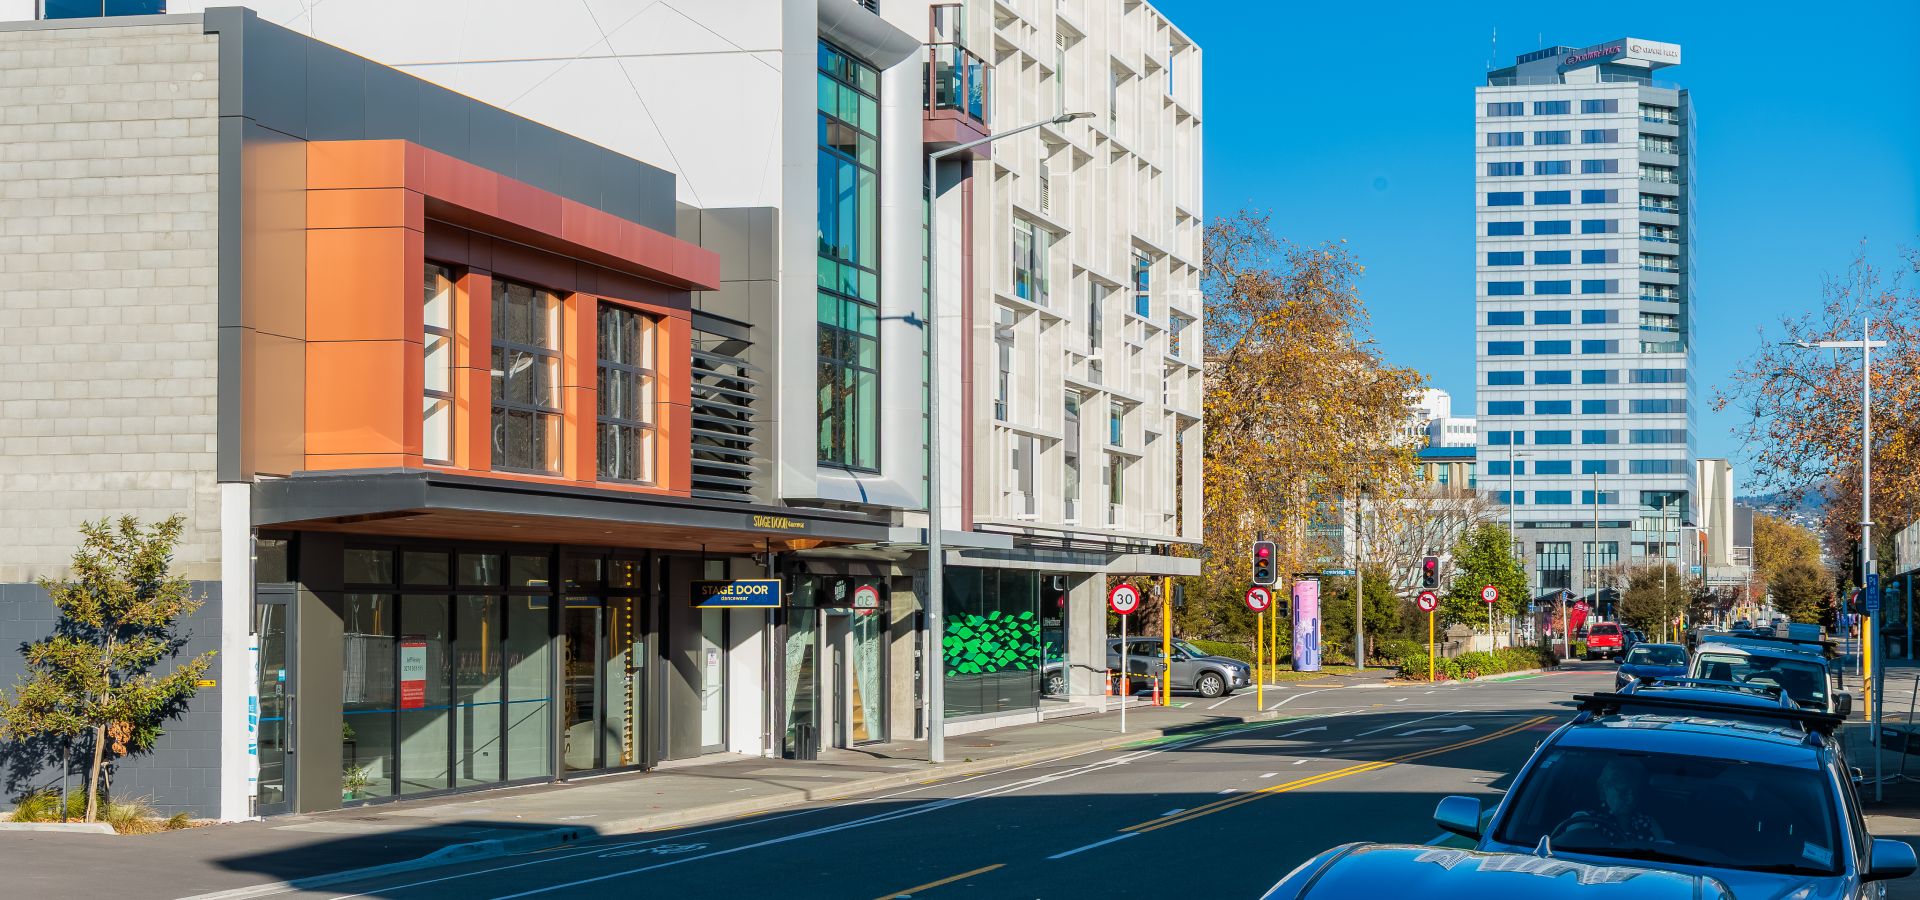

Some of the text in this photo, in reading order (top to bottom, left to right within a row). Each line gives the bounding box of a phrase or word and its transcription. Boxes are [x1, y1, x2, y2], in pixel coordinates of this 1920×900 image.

[753, 515, 771, 528] STAGE
[771, 516, 788, 529] DOOR
[702, 585, 769, 595] STAGE DOOR
[1485, 590, 1495, 598] 30
[1116, 593, 1133, 605] 30
